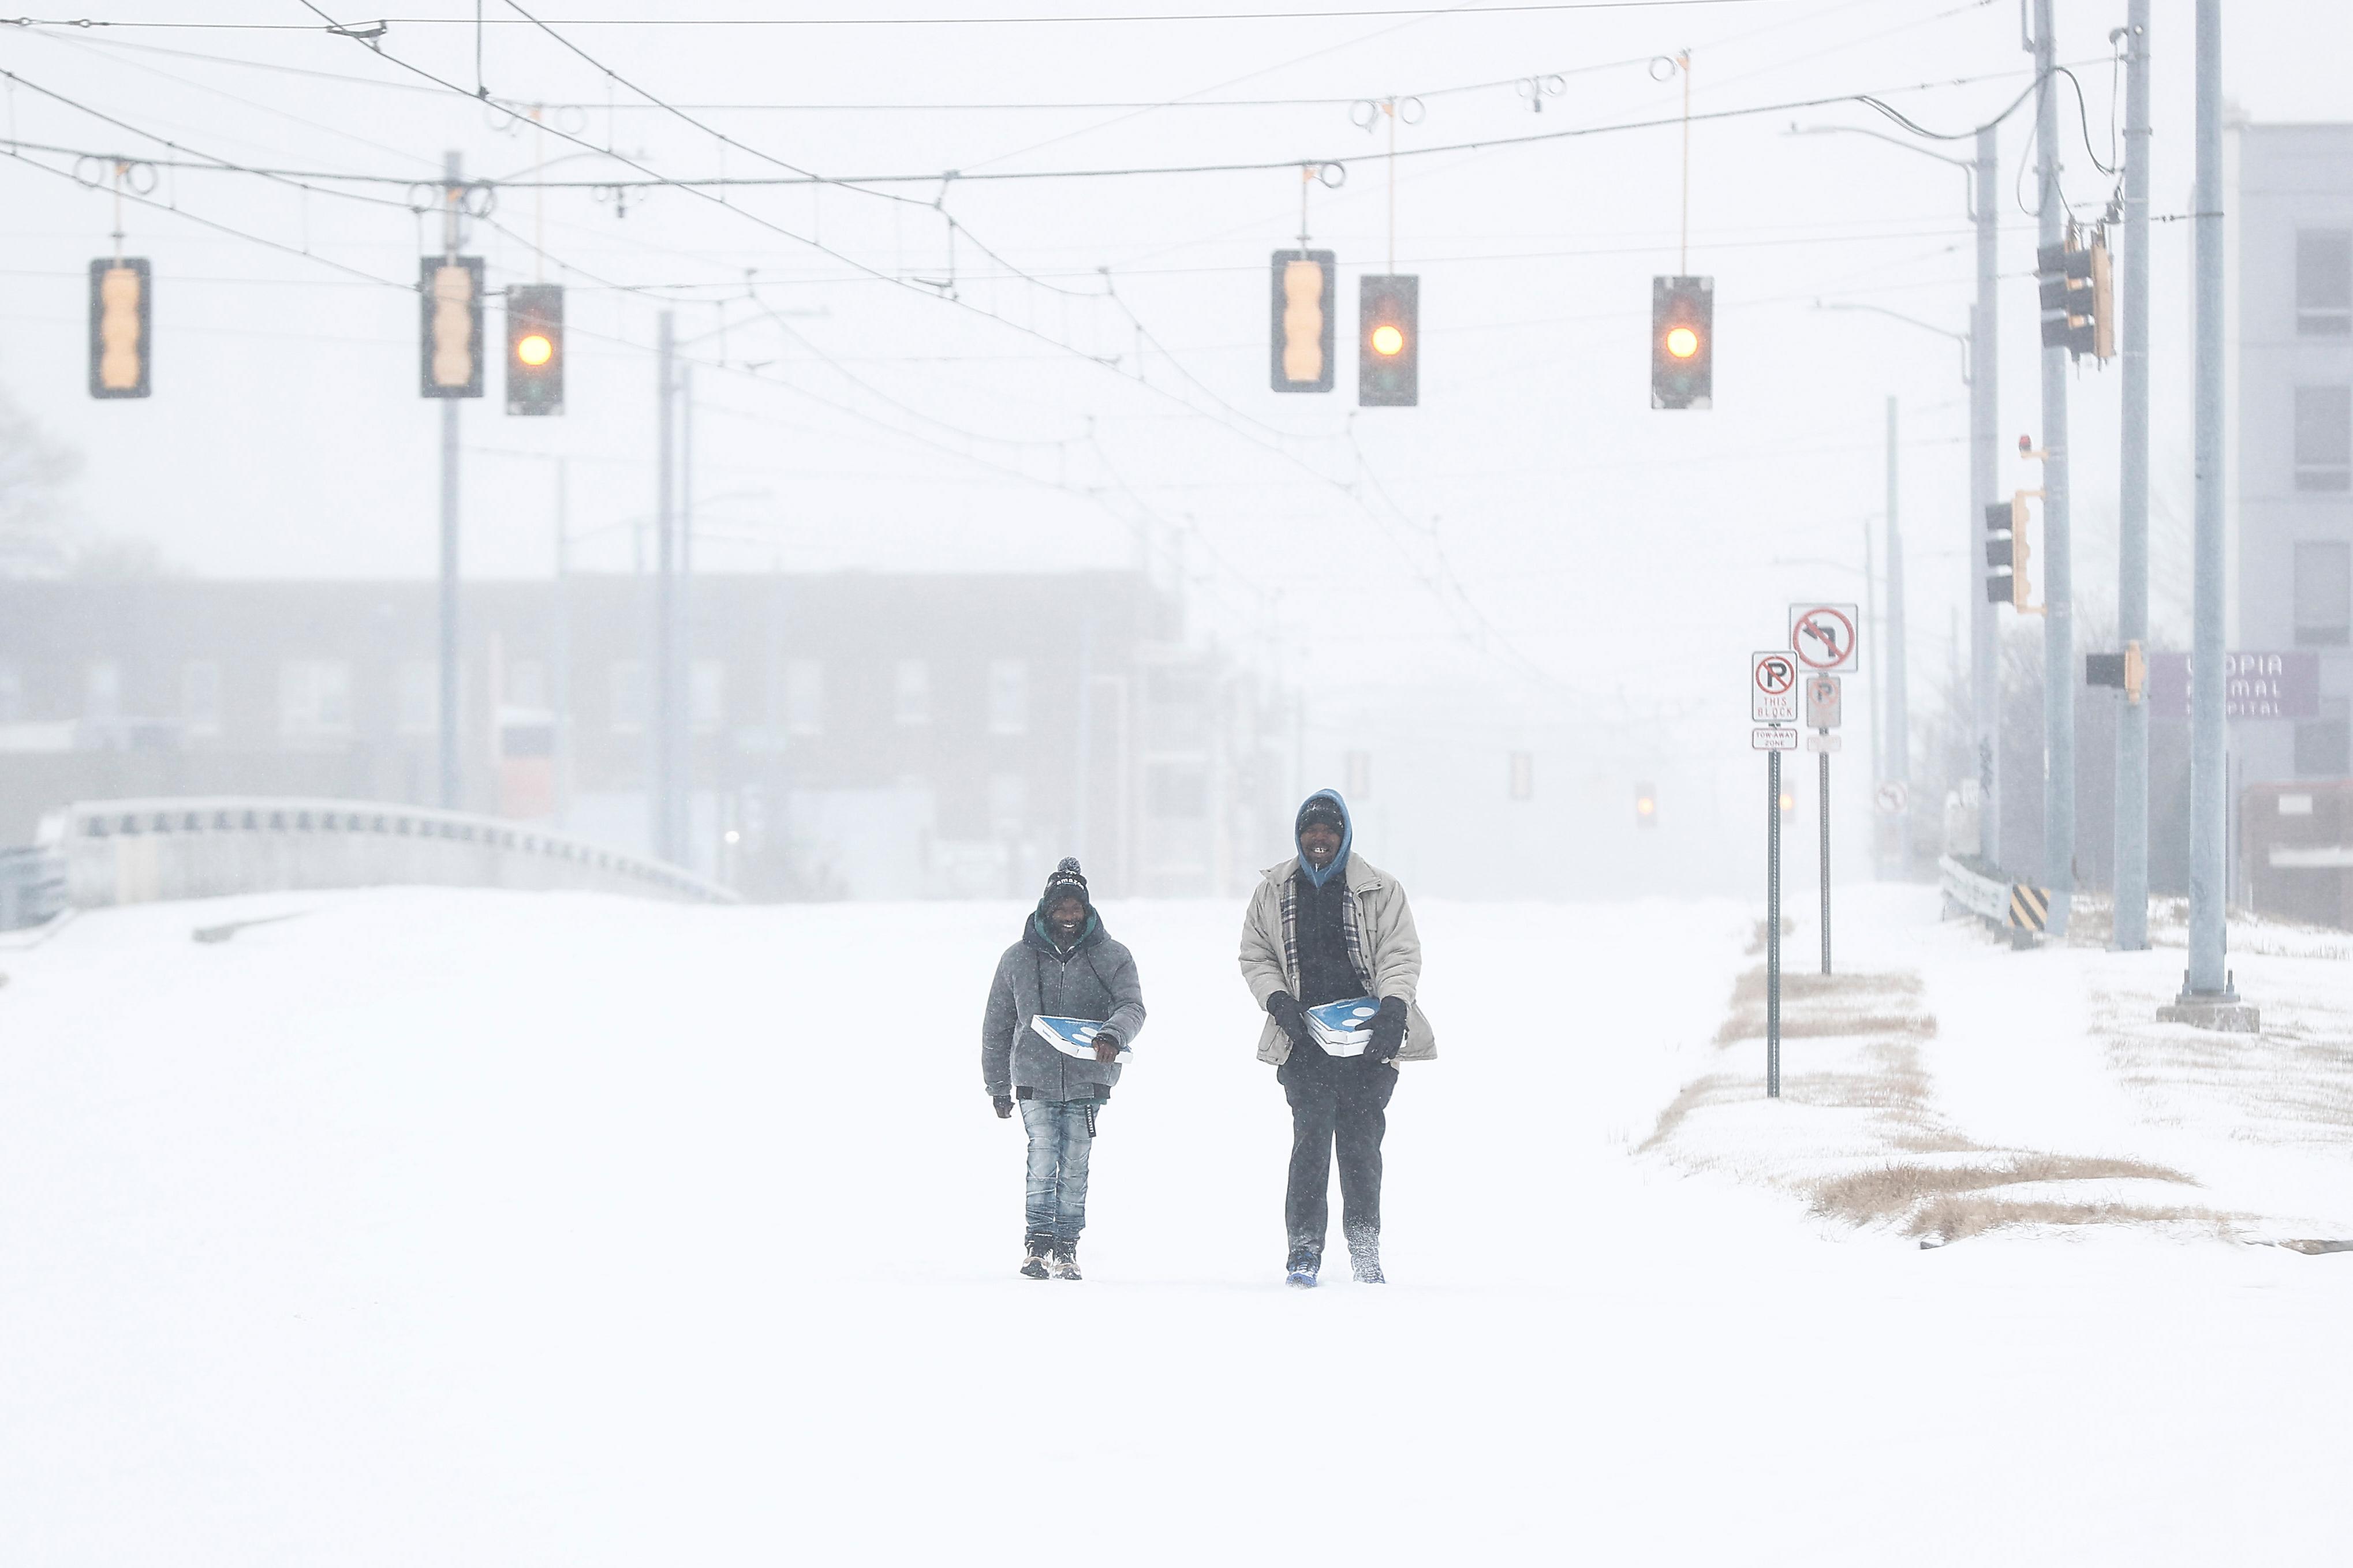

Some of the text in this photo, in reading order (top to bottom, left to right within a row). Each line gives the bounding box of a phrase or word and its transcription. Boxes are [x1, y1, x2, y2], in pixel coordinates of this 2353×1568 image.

[2186, 655, 2282, 676] UOPIA
[1764, 697, 1787, 706] THIS
[1757, 708, 1792, 716] BLOCK
[1056, 878, 1084, 890] amazon
